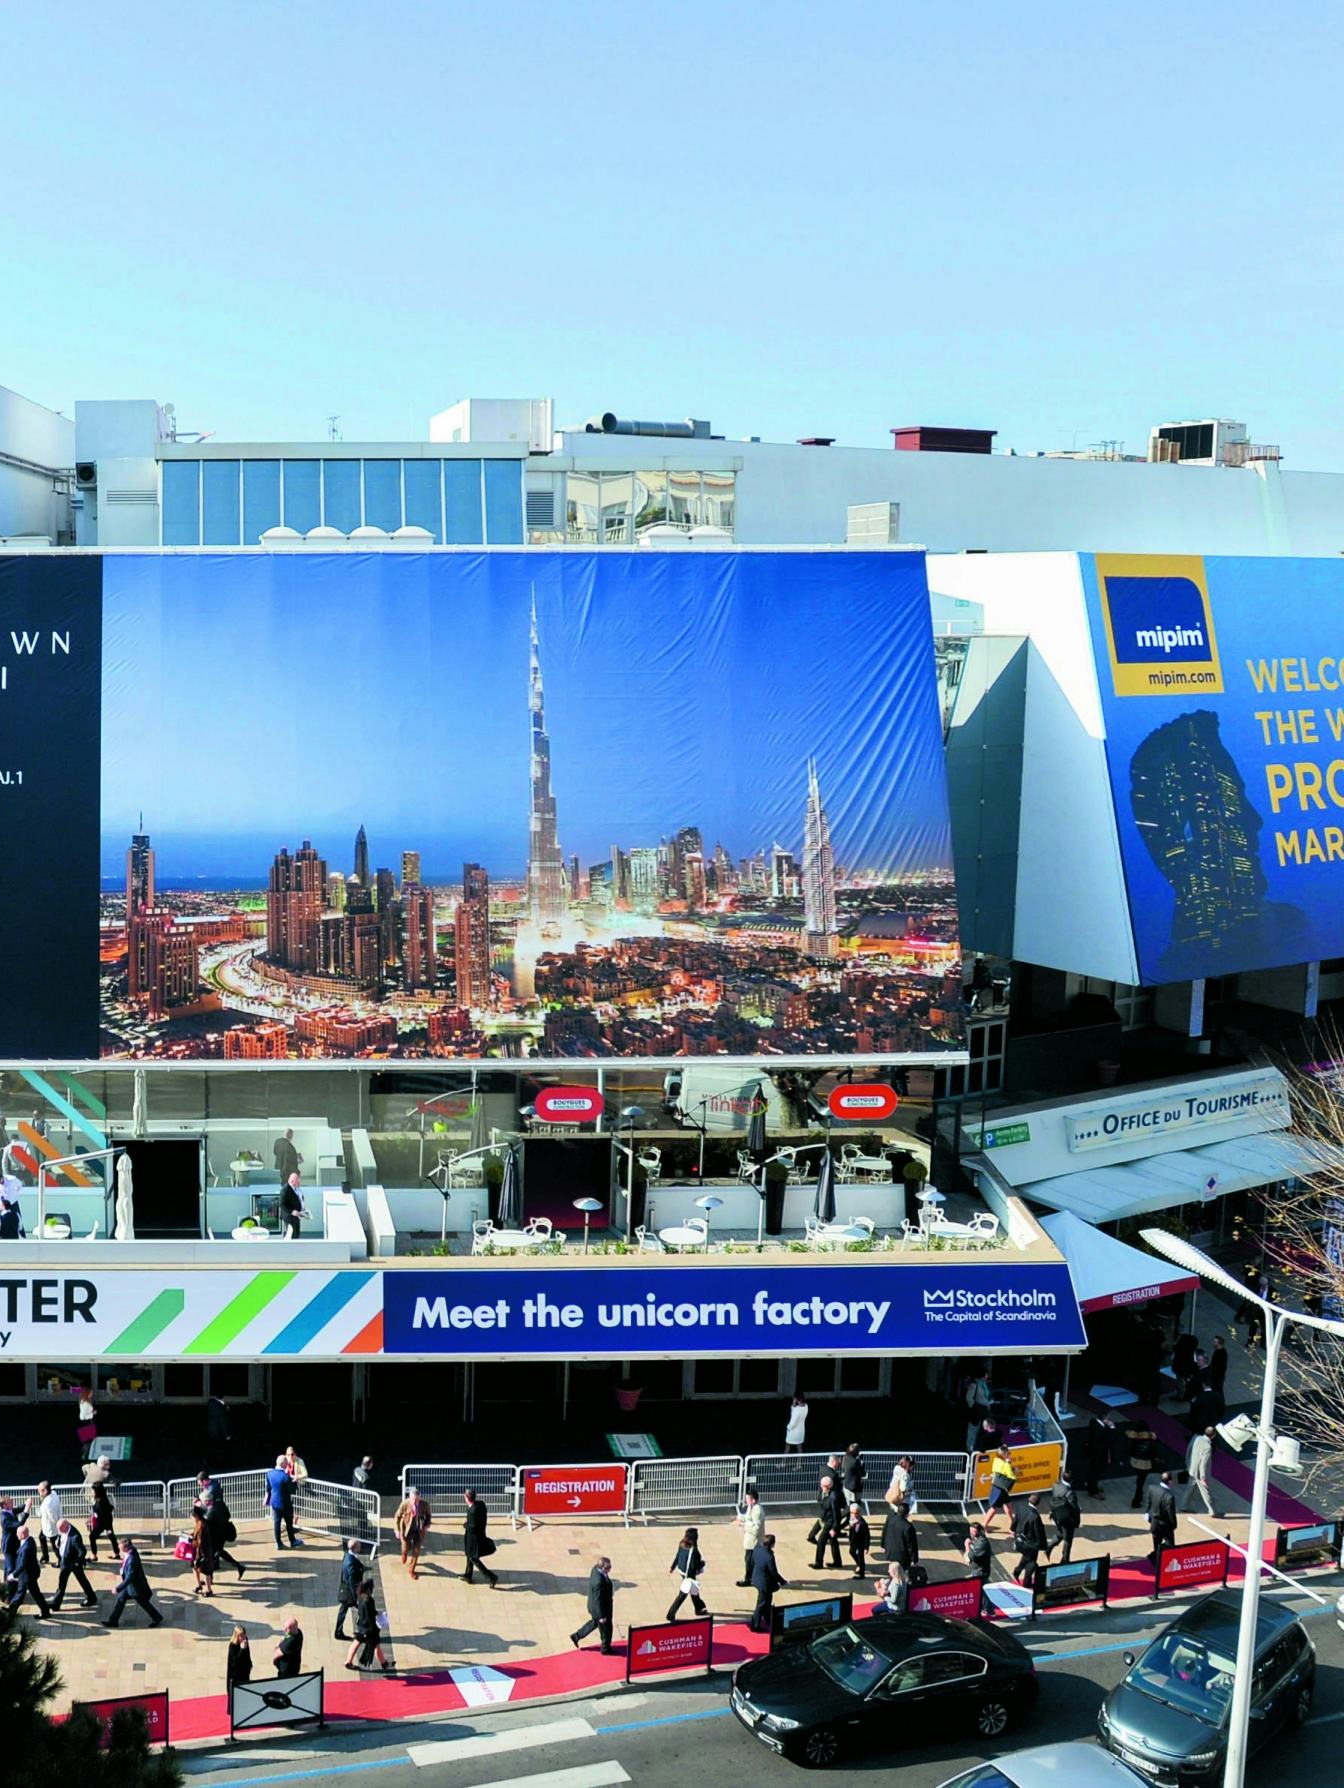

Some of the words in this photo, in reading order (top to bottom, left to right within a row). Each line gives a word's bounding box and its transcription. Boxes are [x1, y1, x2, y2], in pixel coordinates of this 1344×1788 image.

[1136, 625, 1203, 652] mipim
[1148, 670, 1216, 687] mipim.com
[1247, 656, 1344, 693] WELC
[1255, 708, 1319, 745] THE
[1275, 826, 1344, 867] MAR
[956, 1289, 1056, 1307] Stockholm
[1112, 1285, 1160, 1305] REGISTRATION
[411, 1296, 510, 1329] Meet
[522, 1293, 584, 1328] the
[598, 1293, 739, 1327] unicorn
[752, 1290, 891, 1334] factory
[924, 1311, 944, 1322] The
[945, 1310, 981, 1323] Capital
[983, 1310, 994, 1321] of
[995, 1310, 1056, 1321] Scandinavia
[535, 1480, 615, 1494] REGISTRATION
[1183, 1554, 1215, 1564] CUSHMAN
[1183, 1560, 1221, 1570] WAKEFIELD
[933, 1599, 974, 1609] WAKEFIELD
[934, 1593, 968, 1603] CUSHMAN
[658, 1635, 696, 1646] CUSHMAN
[658, 1641, 703, 1652] WAKEFIELD
